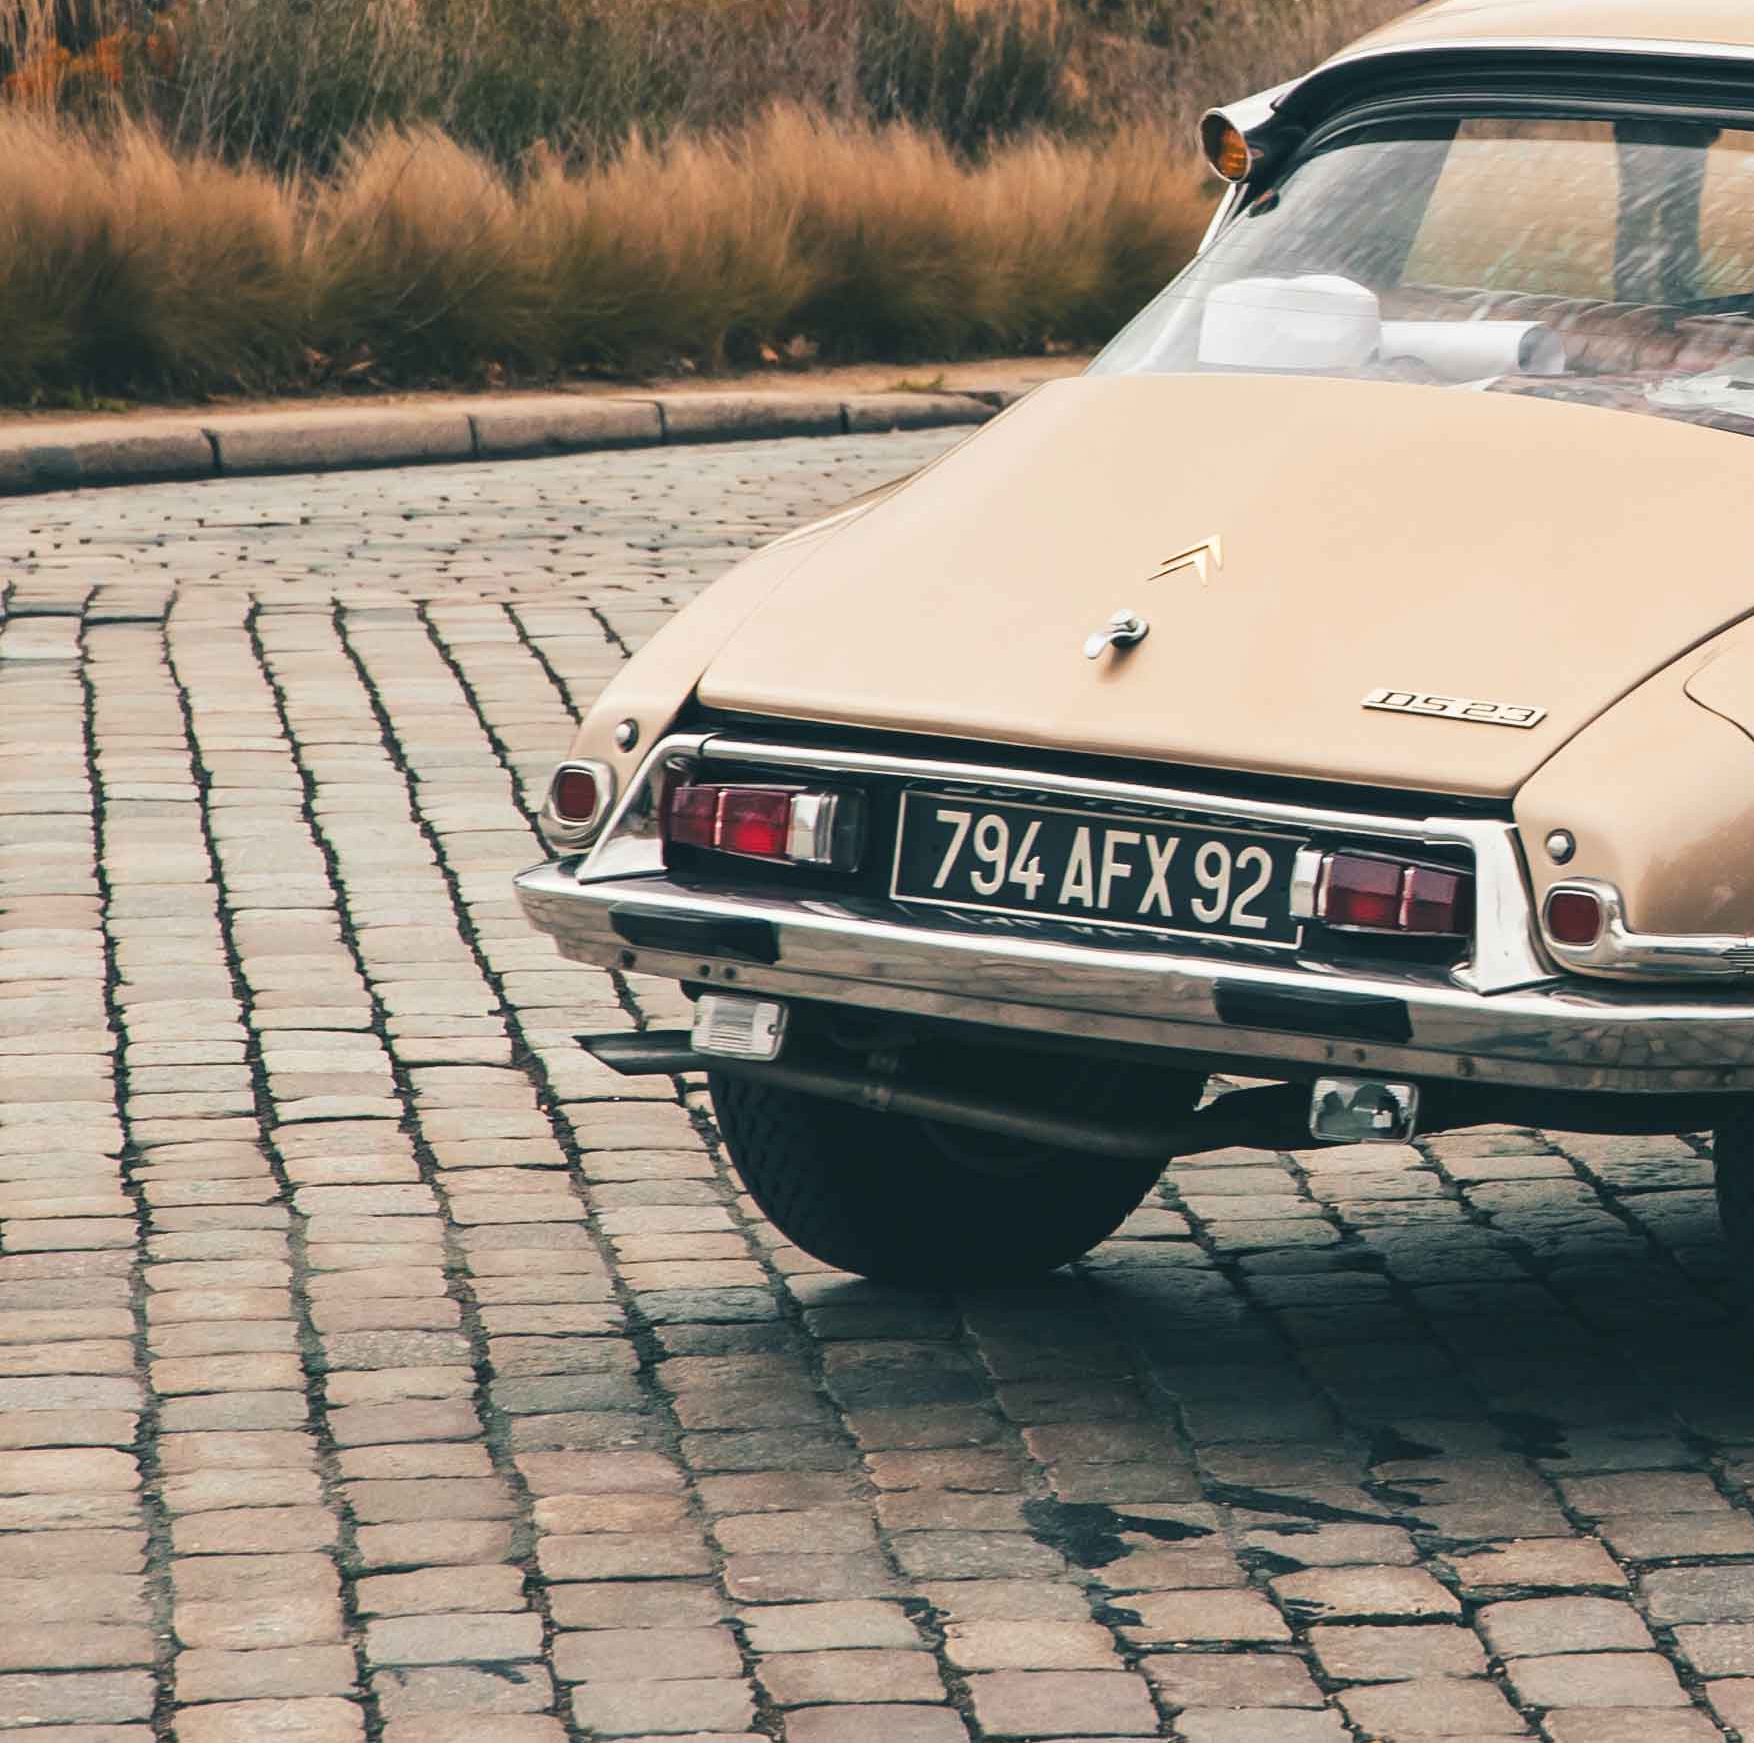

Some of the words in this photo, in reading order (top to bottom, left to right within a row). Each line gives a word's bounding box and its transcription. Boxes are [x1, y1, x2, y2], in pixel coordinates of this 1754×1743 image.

[1369, 691, 1456, 712] DS
[1461, 702, 1537, 722] 23
[932, 809, 1046, 901] 794
[1057, 826, 1181, 918] AFX
[1190, 840, 1274, 929] 92
